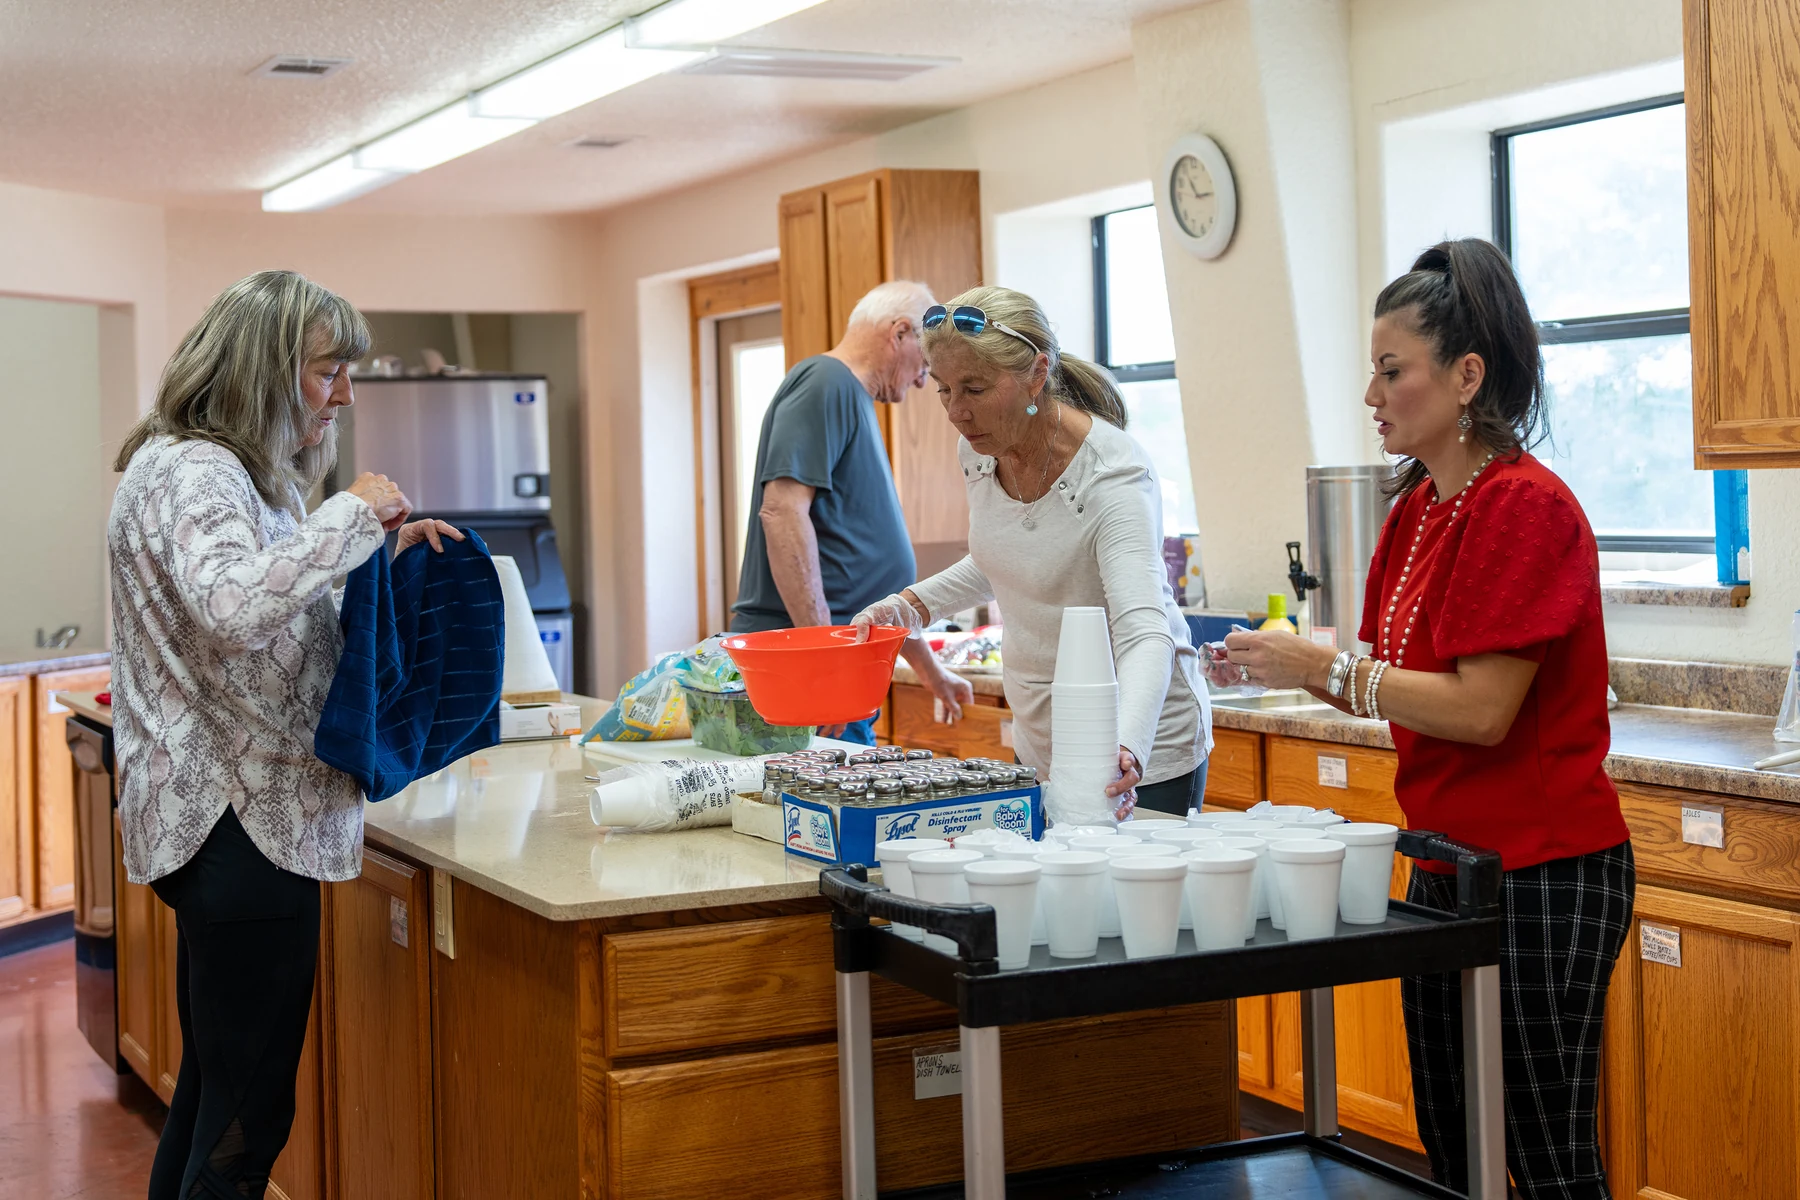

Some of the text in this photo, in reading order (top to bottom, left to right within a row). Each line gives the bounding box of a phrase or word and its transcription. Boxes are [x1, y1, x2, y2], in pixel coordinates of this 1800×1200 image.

[928, 813, 982, 827] Disinfectant
[996, 810, 1025, 822] Baby's
[885, 815, 920, 841] Lysol
[943, 824, 967, 834] Spray
[1000, 820, 1025, 829] Room
[916, 1055, 943, 1068] APRONS
[916, 1064, 962, 1078] DISH TOWEL
